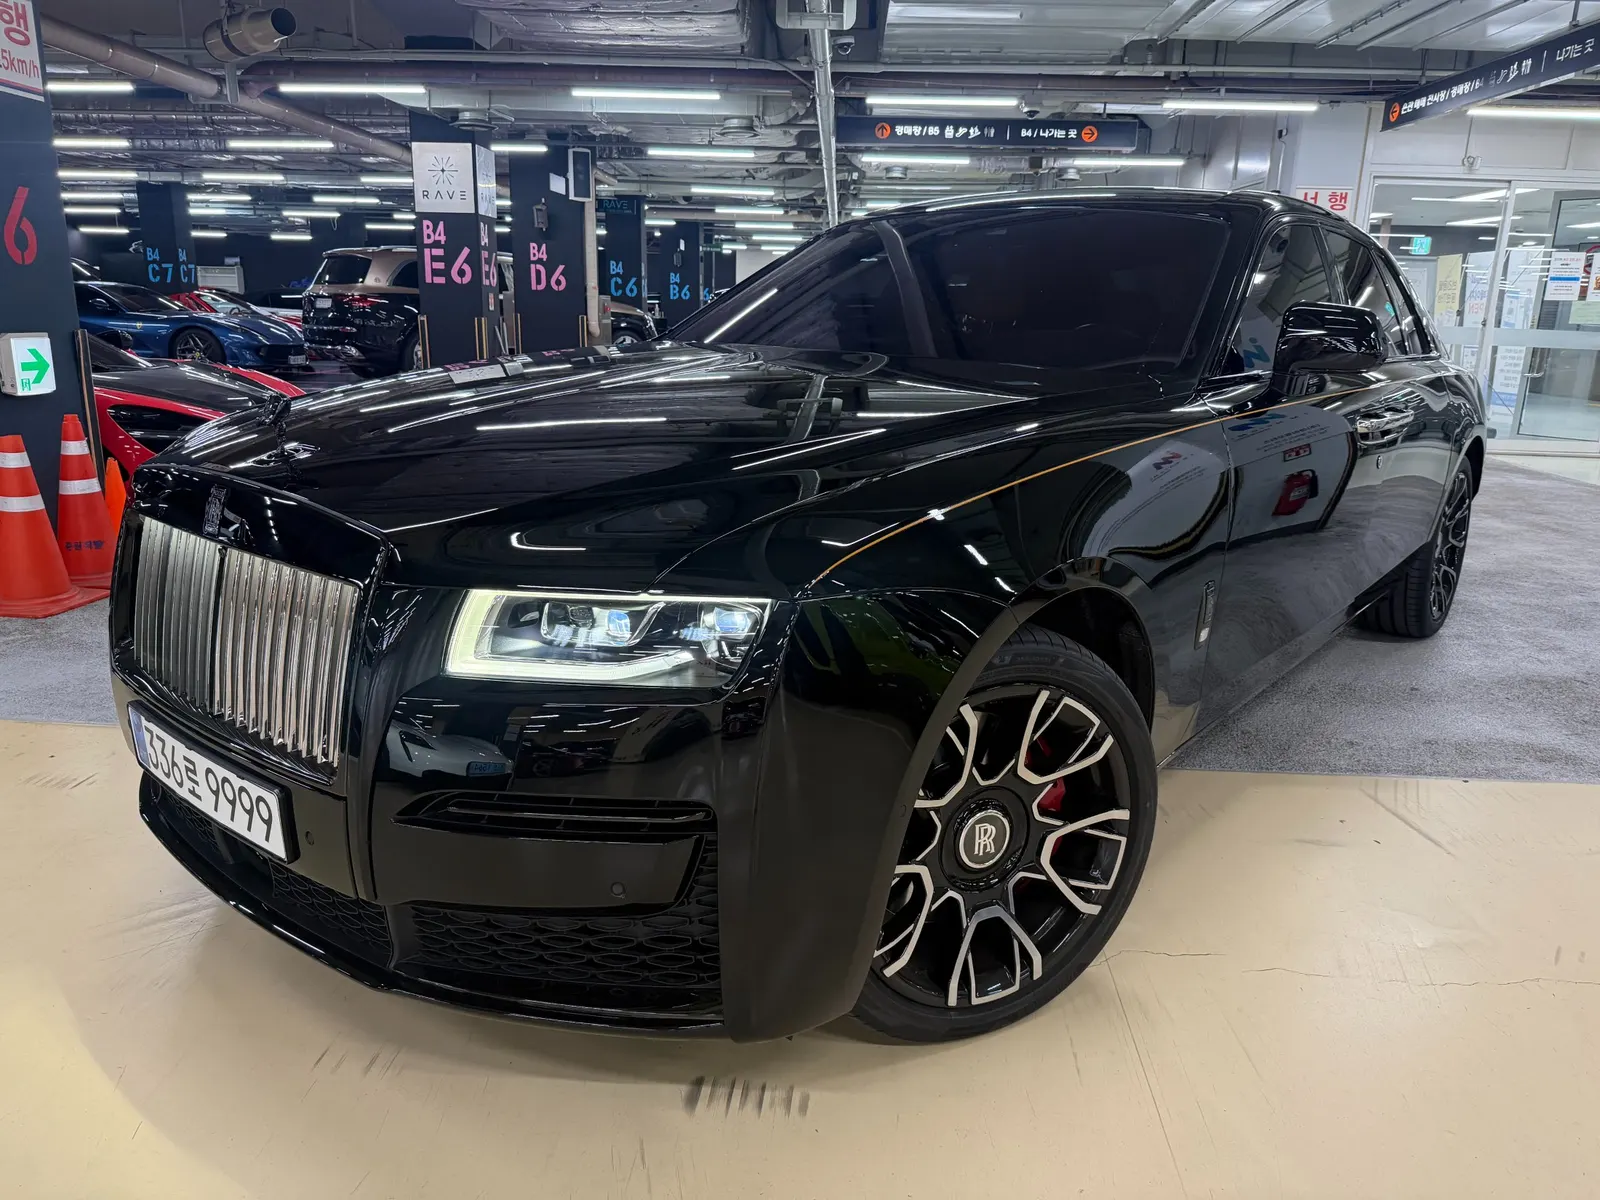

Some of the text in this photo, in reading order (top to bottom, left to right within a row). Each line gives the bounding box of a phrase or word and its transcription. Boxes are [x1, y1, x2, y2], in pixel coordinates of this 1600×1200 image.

[0, 0, 31, 46] 행
[1556, 38, 1595, 62] 나가는 곳
[0, 48, 40, 79] 5km/h
[1067, 128, 1078, 139] 곳
[422, 190, 467, 200] RAVE
[4, 186, 38, 265] 6
[422, 219, 446, 245] B4
[480, 221, 489, 247] B4
[146, 247, 160, 261] B4
[178, 248, 187, 261] B4
[529, 242, 548, 262] B4
[148, 263, 173, 283] C7
[180, 263, 195, 284] C7
[423, 246, 473, 285] E6
[481, 250, 497, 287] E6
[609, 260, 624, 275] B4
[530, 263, 567, 292] D6
[610, 277, 638, 298] C6
[669, 272, 681, 284] B4
[669, 284, 691, 300] B6
[204, 767, 273, 844] 9999
